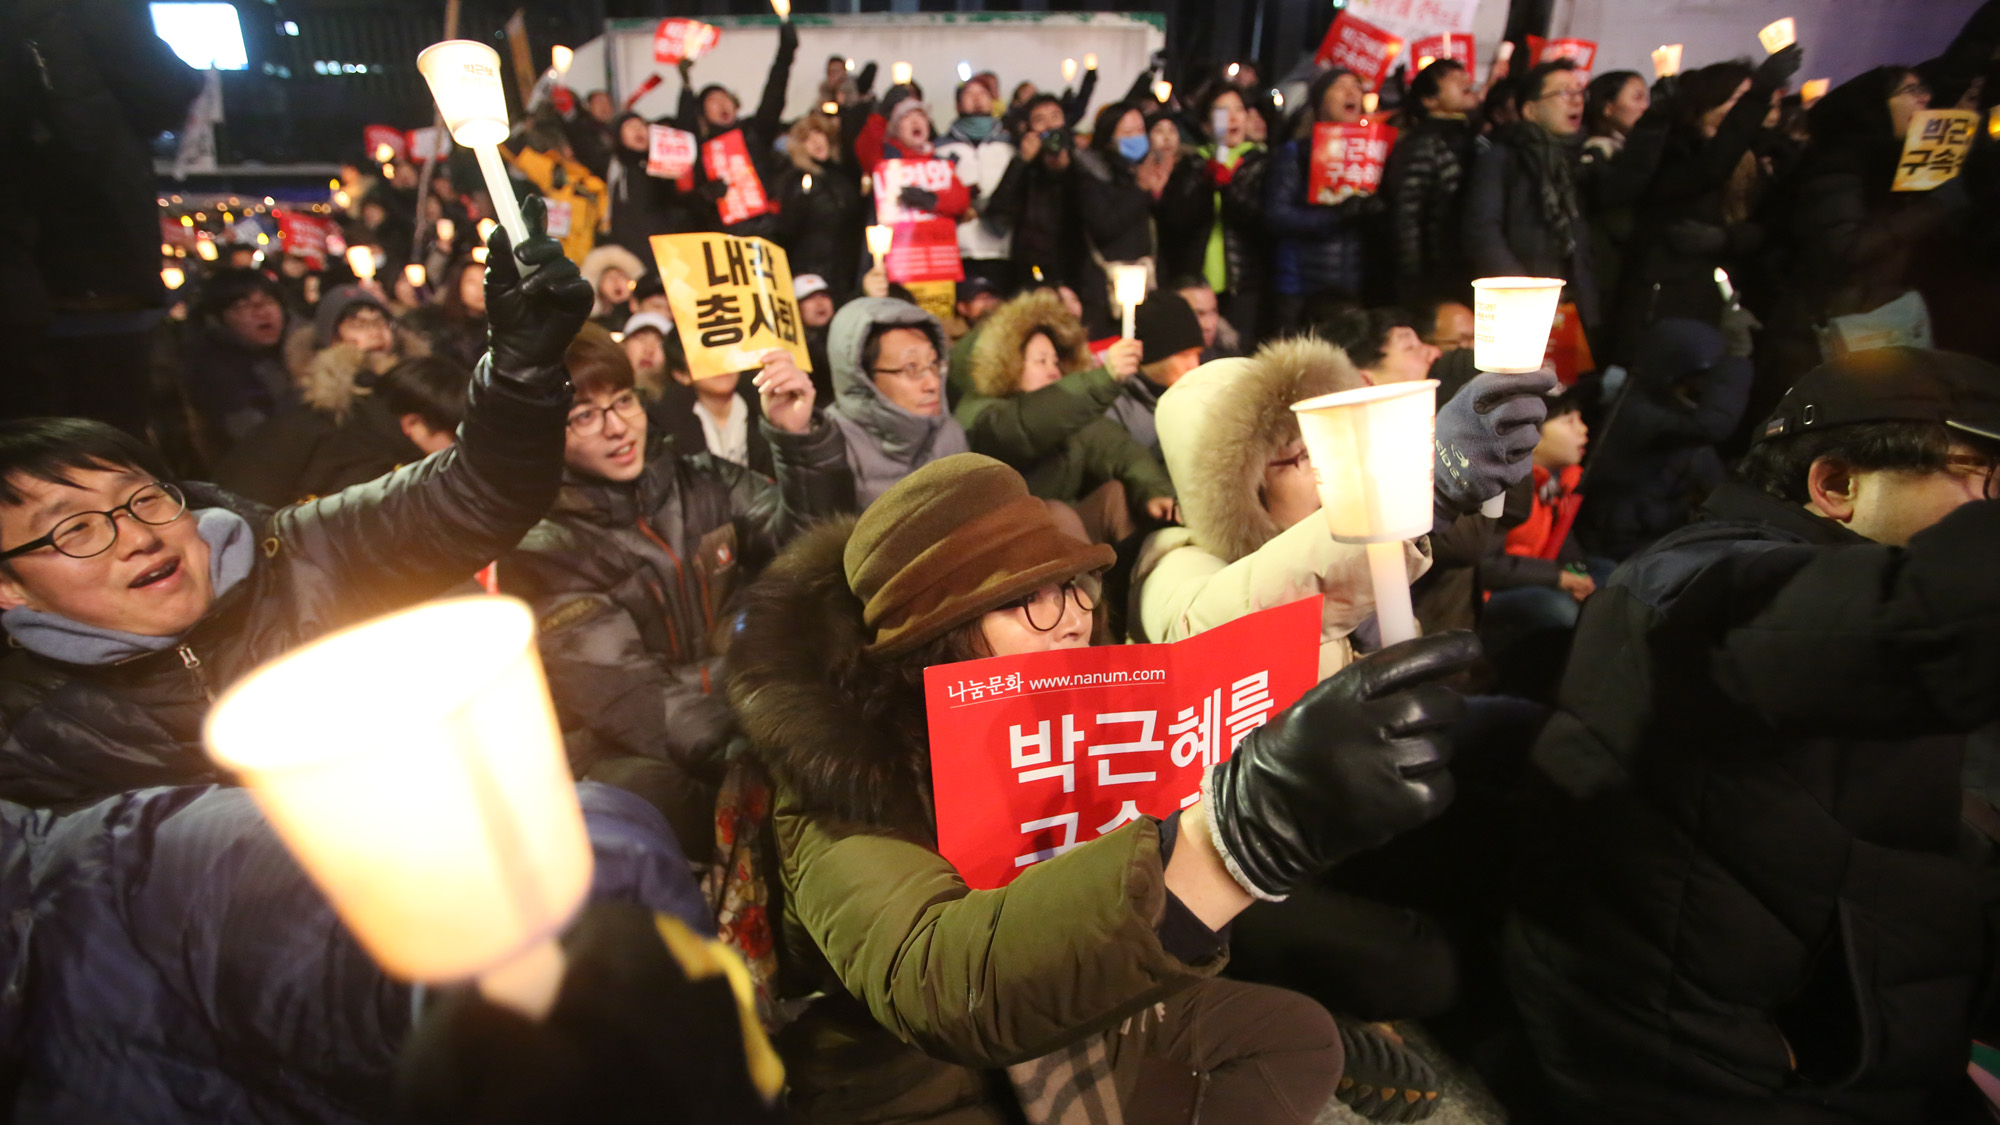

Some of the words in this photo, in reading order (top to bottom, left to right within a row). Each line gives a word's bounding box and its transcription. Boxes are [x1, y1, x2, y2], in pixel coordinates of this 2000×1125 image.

[702, 239, 777, 290] 내각
[696, 293, 798, 347] 총사퇴
[947, 671, 1024, 702] 나눔문화
[1029, 669, 1166, 690] www.nanum.com
[1009, 670, 1275, 793] 박근혜를
